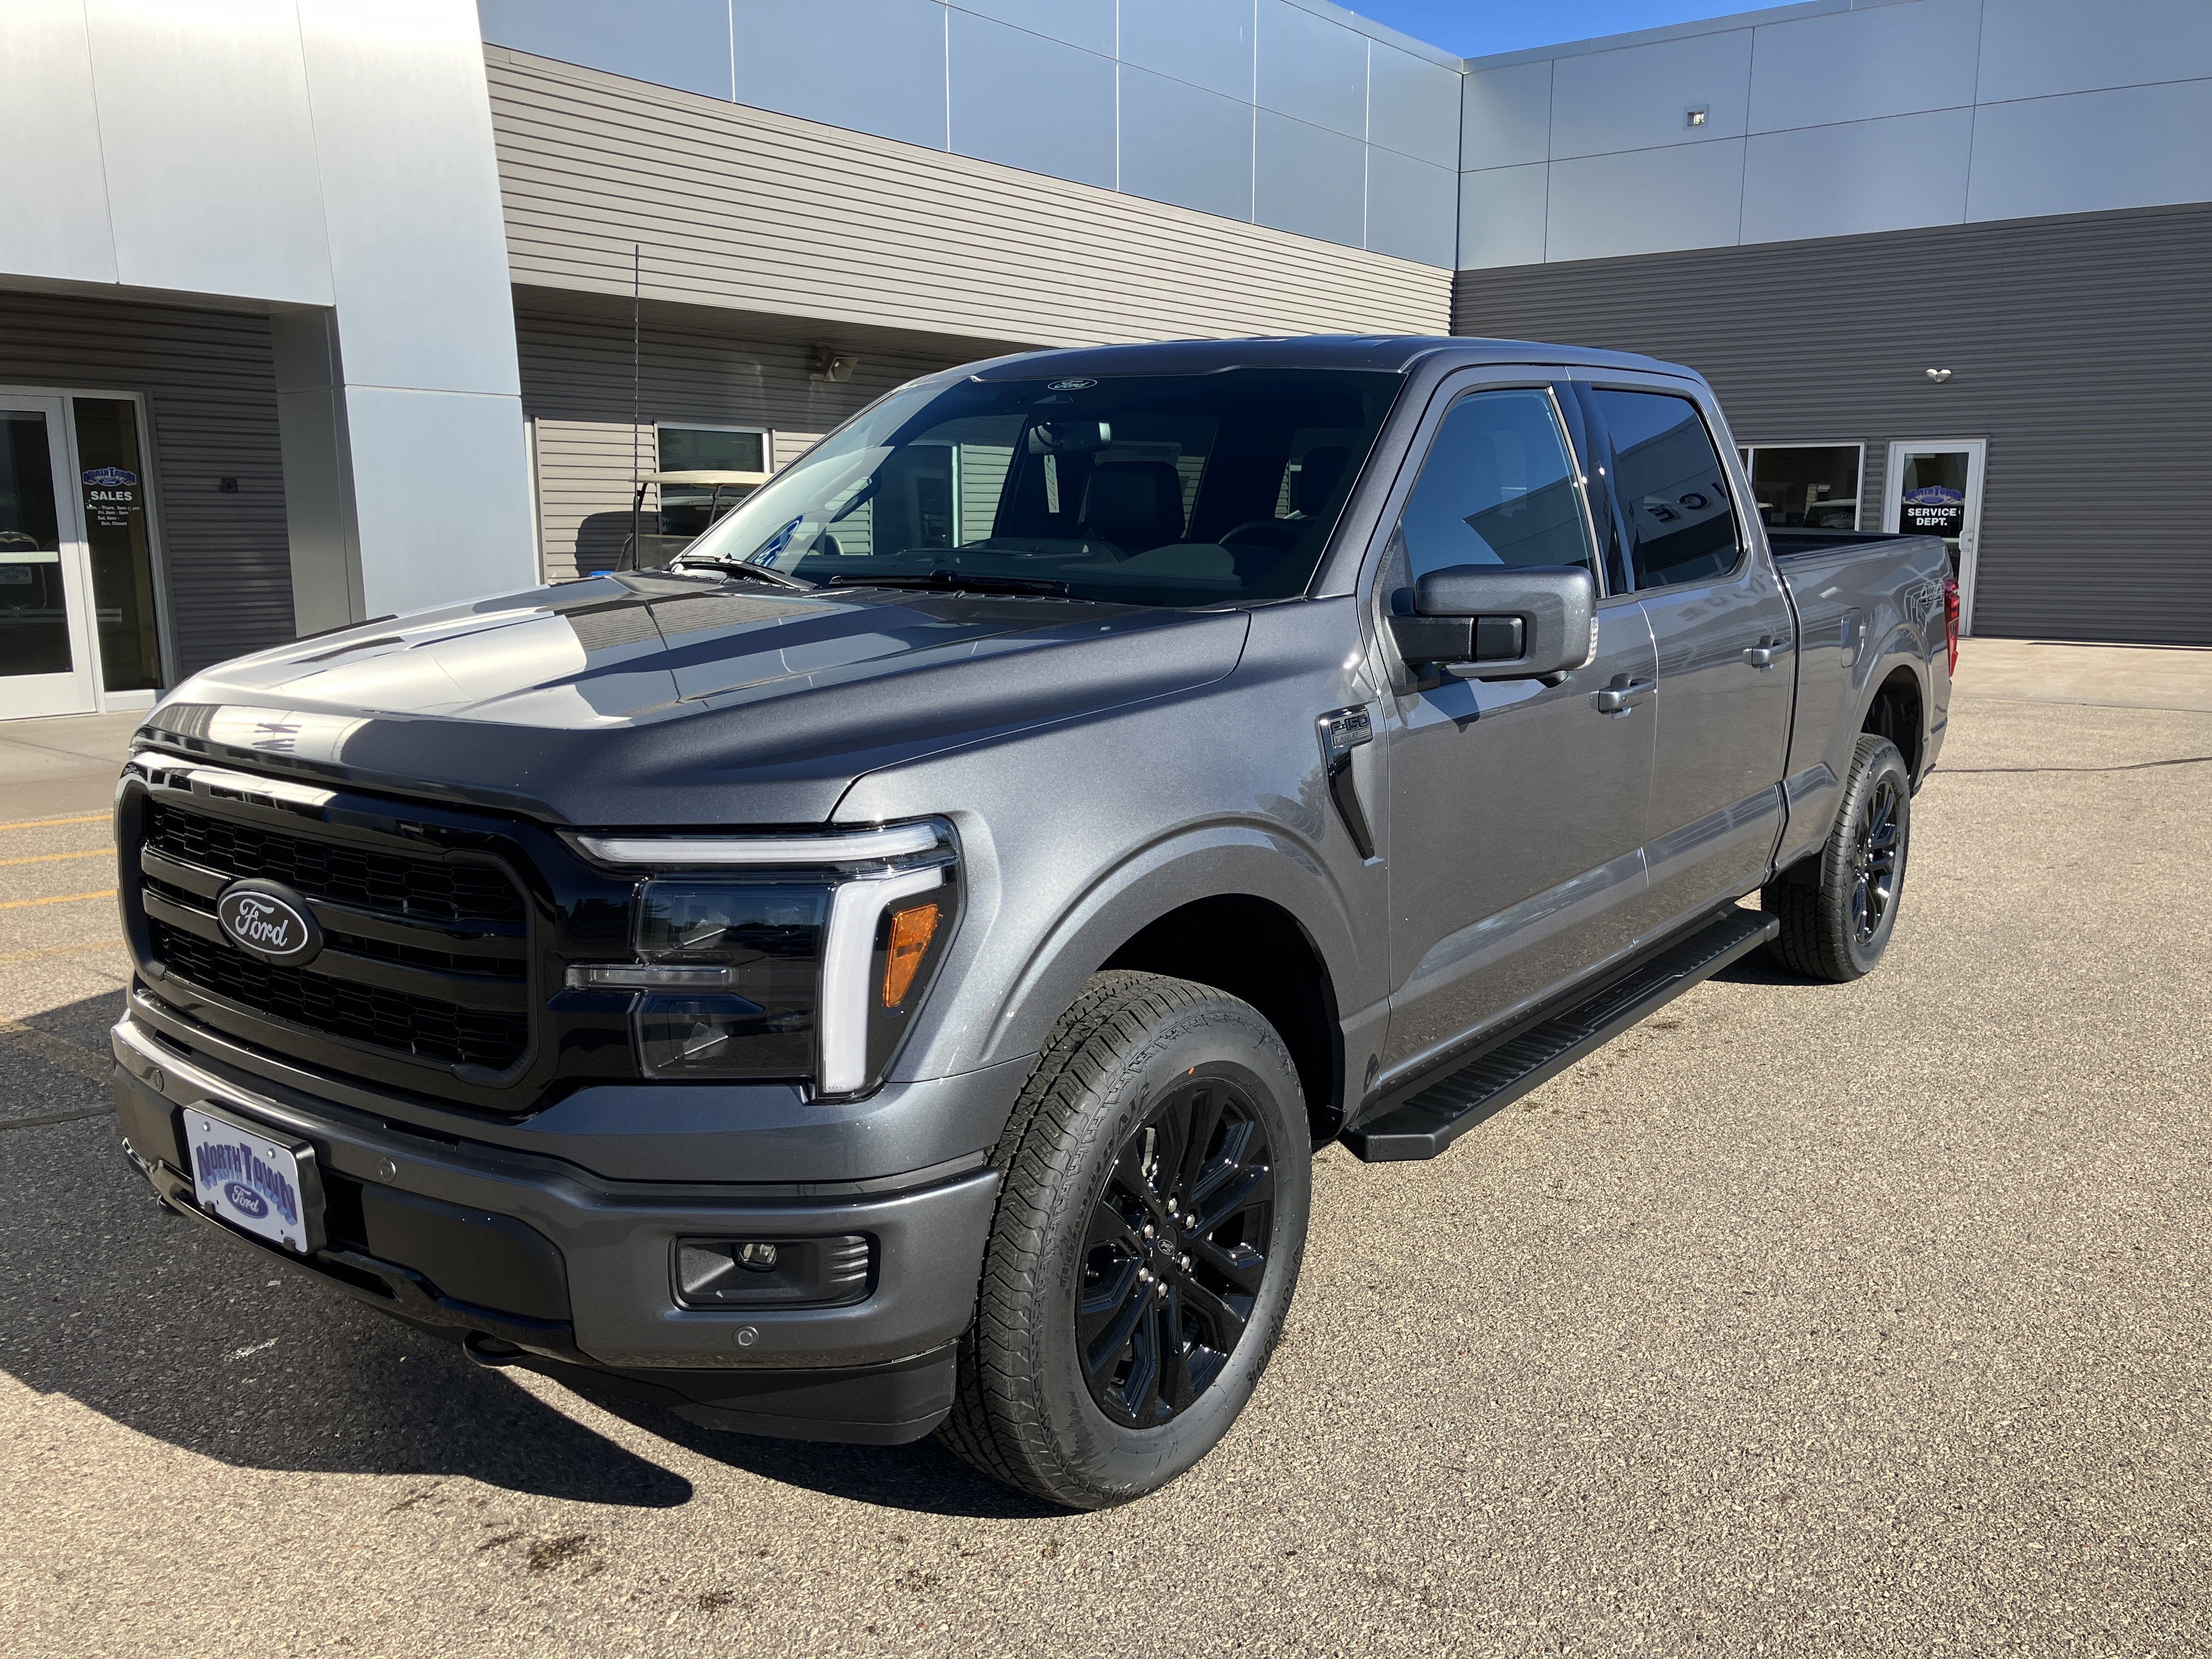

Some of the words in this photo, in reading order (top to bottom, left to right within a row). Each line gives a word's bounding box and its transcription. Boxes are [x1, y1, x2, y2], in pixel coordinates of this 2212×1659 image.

[1054, 380, 1090, 388] Ford
[91, 491, 132, 501] SALES
[1908, 508, 1956, 516] SERVICE
[1916, 517, 1947, 526] DEPT.
[1330, 714, 1369, 735] F-150
[1335, 731, 1359, 743] LARIAT
[235, 898, 289, 947] Ford
[232, 1185, 259, 1213] Ford
[1160, 1241, 1173, 1253] Ford
